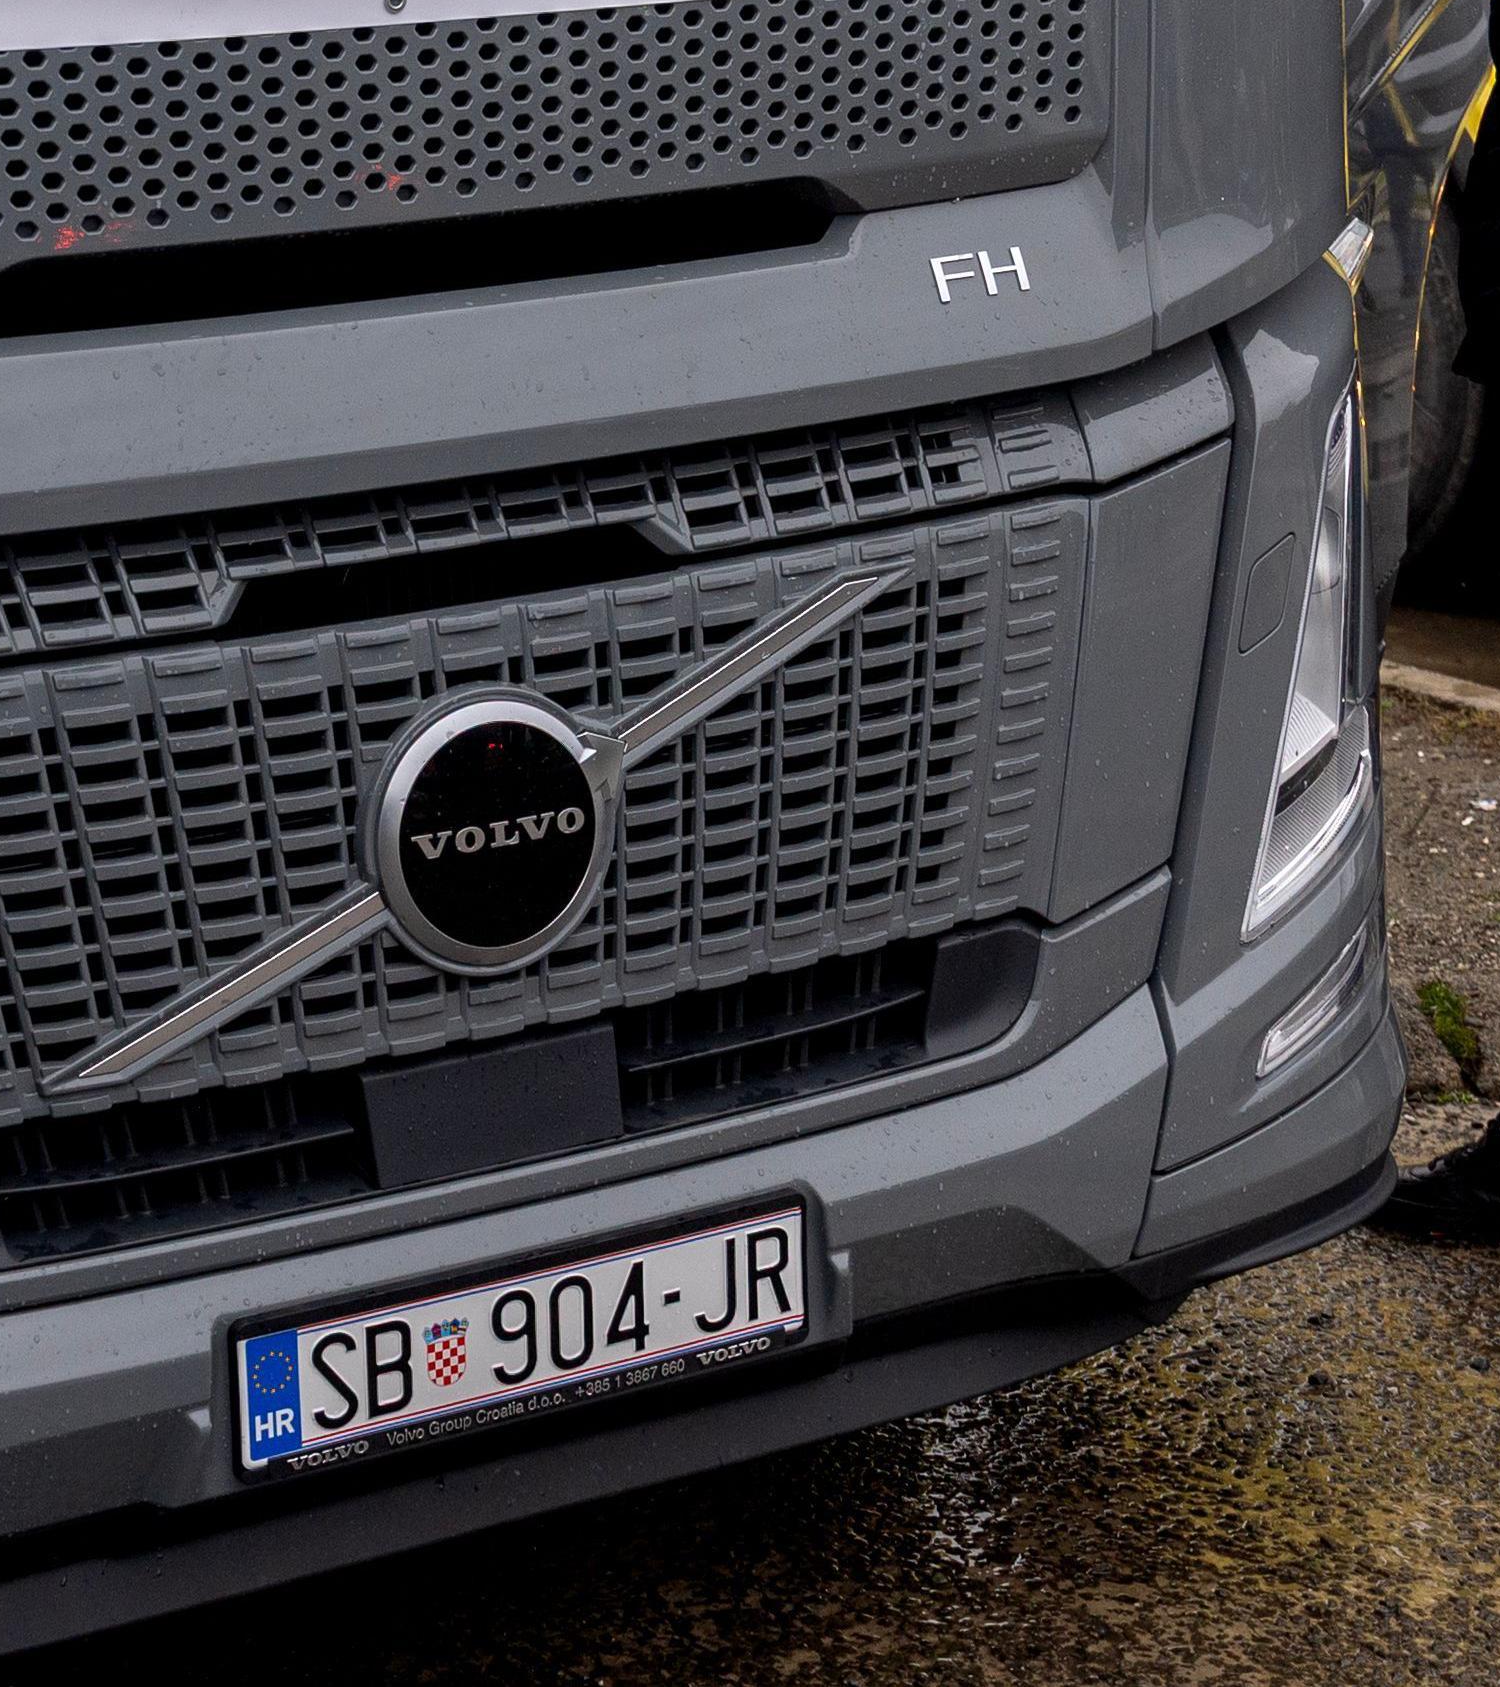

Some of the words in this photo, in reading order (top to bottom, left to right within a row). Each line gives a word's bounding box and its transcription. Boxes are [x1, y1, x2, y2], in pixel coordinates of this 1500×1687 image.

[929, 245, 1031, 303] FH
[410, 807, 585, 860] VOLVO
[311, 1320, 413, 1430] SB
[491, 1226, 793, 1385] 904-JR
[254, 1407, 295, 1442] HR
[287, 1439, 370, 1471] VOLVO
[386, 1424, 425, 1446] Volvo
[429, 1415, 472, 1437] Group
[475, 1399, 524, 1424] Croatia
[528, 1393, 567, 1412] d.o.o.
[575, 1378, 610, 1399] +385
[615, 1374, 622, 1389] 1
[625, 1363, 658, 1386] 3867
[661, 1357, 686, 1378] 660
[696, 1336, 771, 1366] VOLVO
